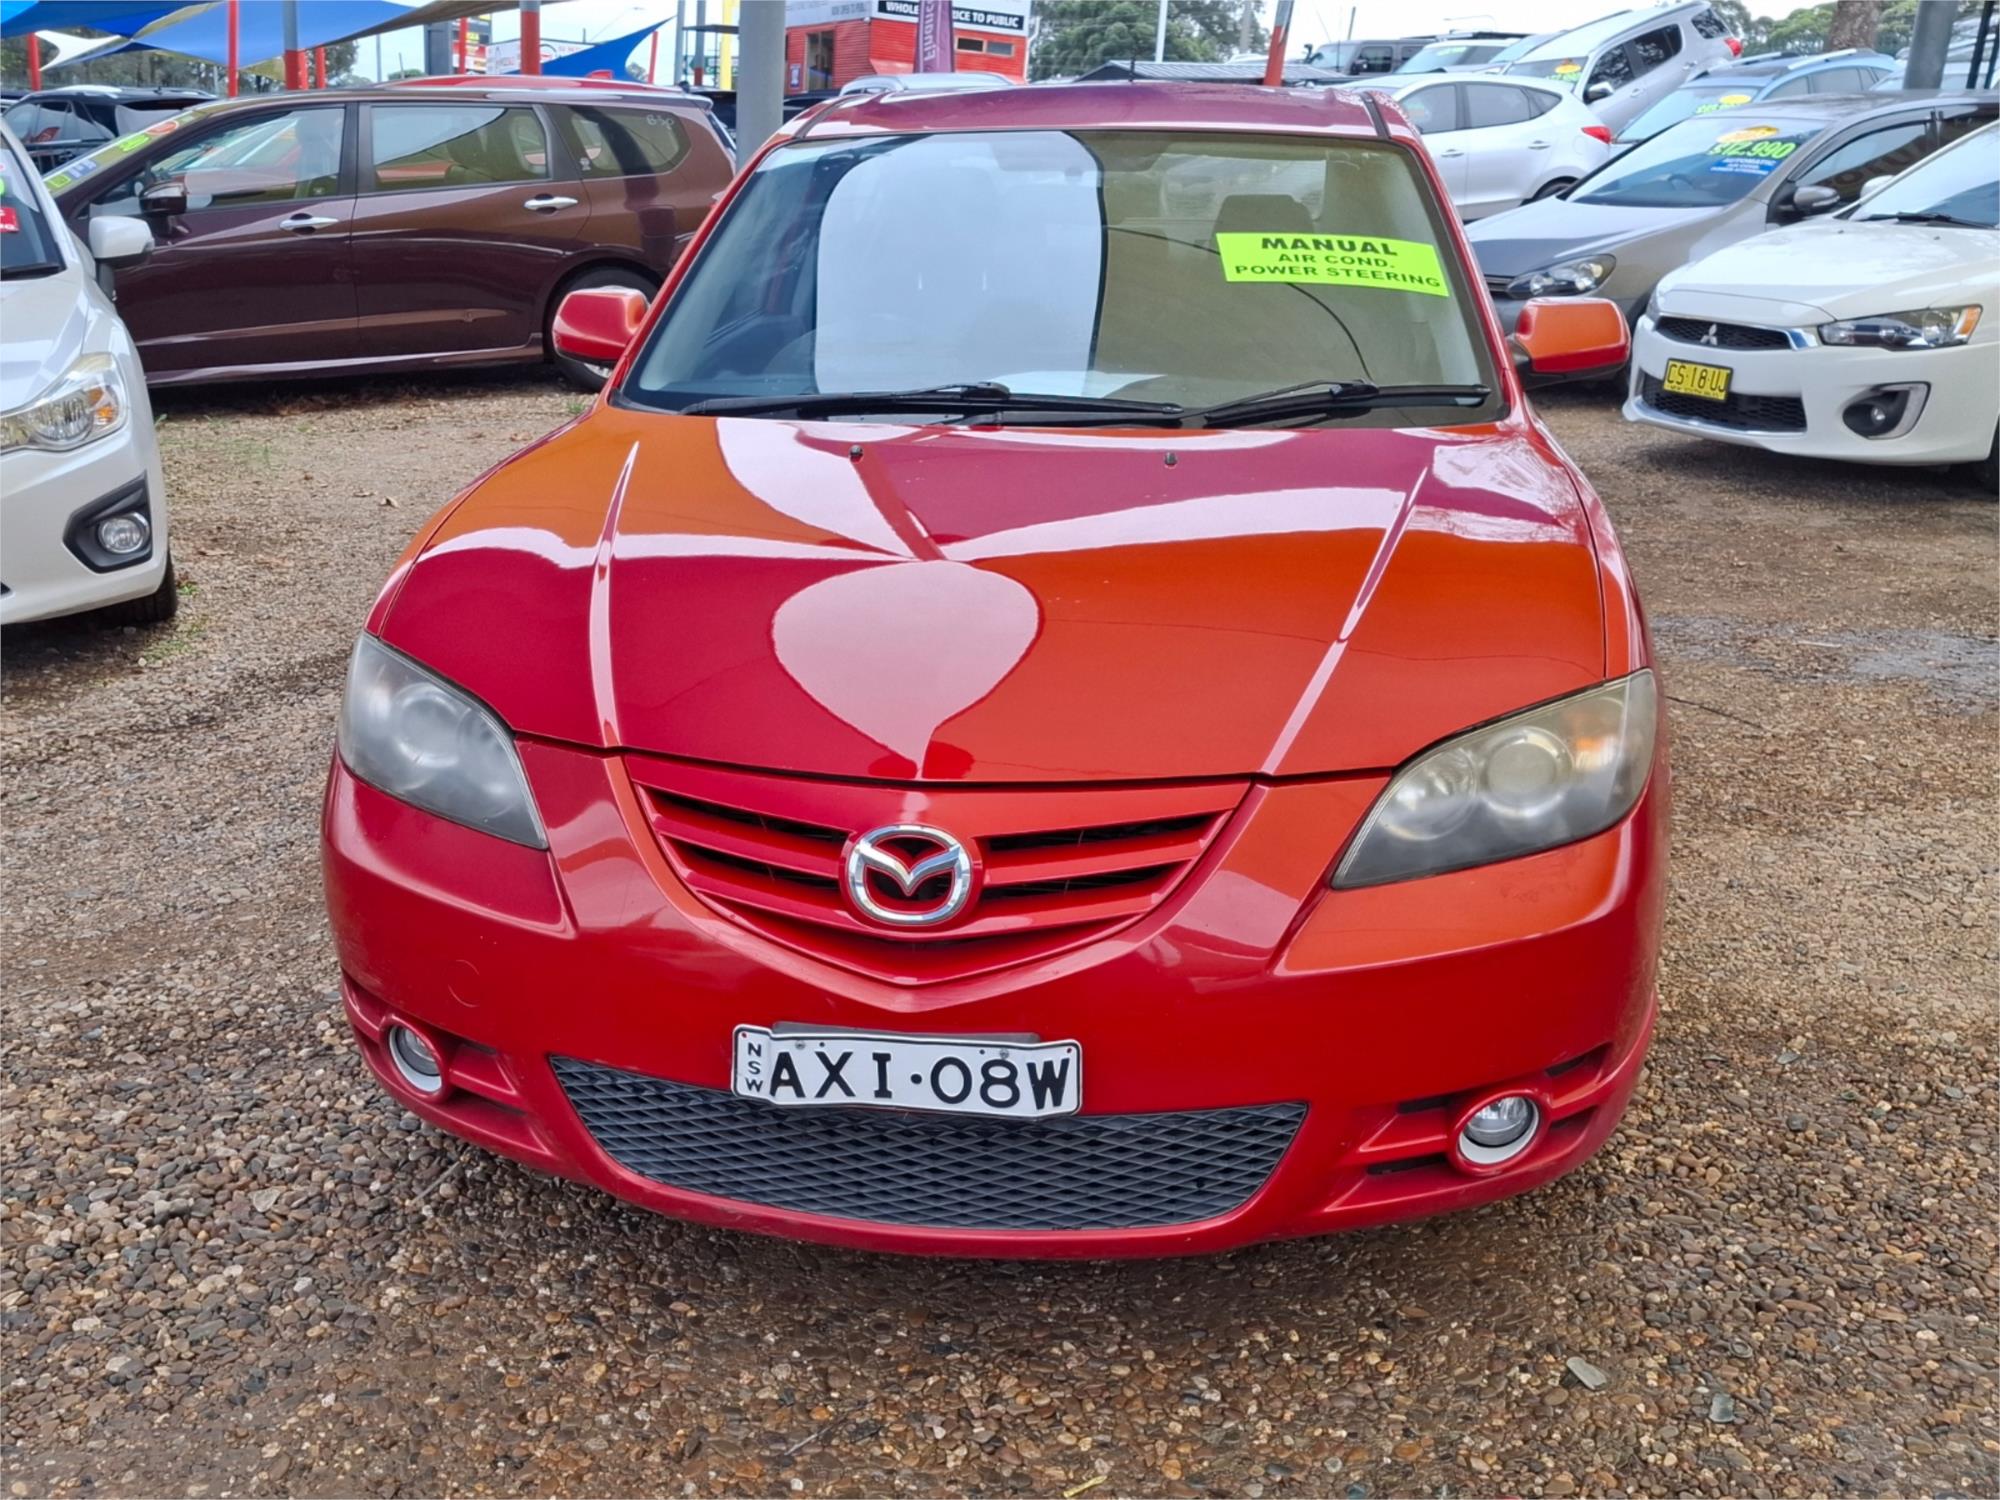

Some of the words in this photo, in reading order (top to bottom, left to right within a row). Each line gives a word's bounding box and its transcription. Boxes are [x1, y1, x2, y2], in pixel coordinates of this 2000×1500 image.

[886, 1, 919, 15] WHOLE
[972, 12, 985, 23] TO
[986, 14, 1019, 28] PUBLIC
[1261, 237, 1398, 256] MANUAL
[1278, 253, 1317, 264] AIR
[1324, 254, 1396, 269] COND.
[1235, 265, 1318, 276] POWER
[1327, 267, 1441, 288] STEERING
[745, 1041, 764, 1094] NSW
